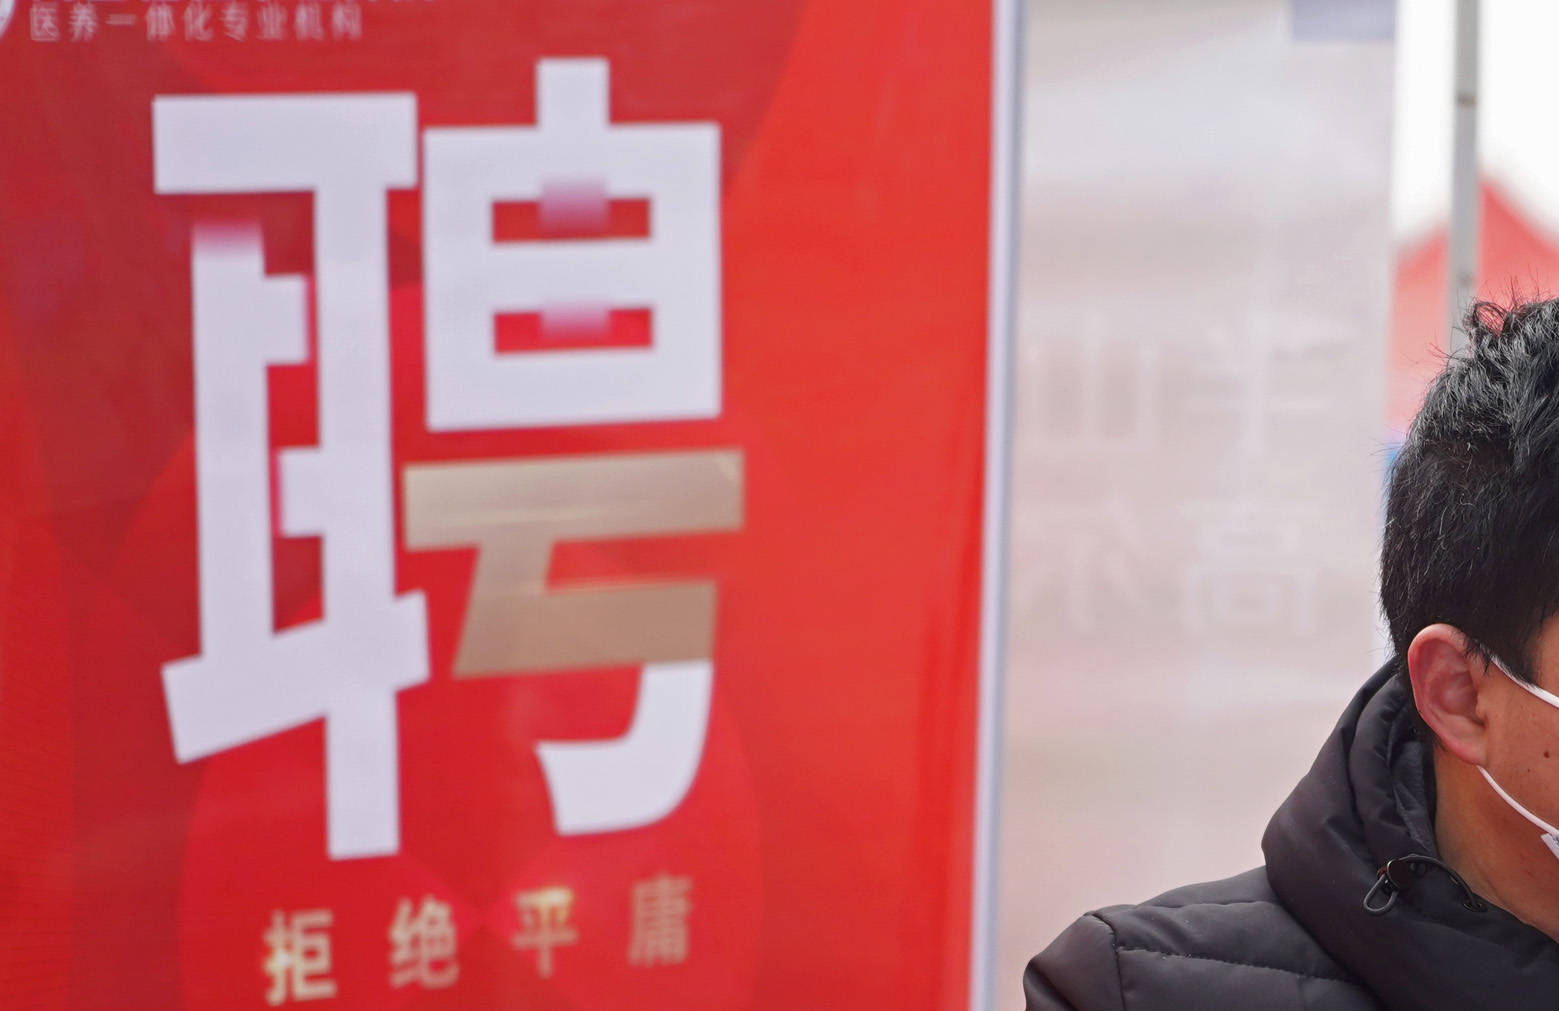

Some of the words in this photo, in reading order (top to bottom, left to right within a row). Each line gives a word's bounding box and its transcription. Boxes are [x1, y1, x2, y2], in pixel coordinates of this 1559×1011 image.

[153, 58, 746, 859] 聘
[263, 871, 693, 1007] 拒绝平庸
